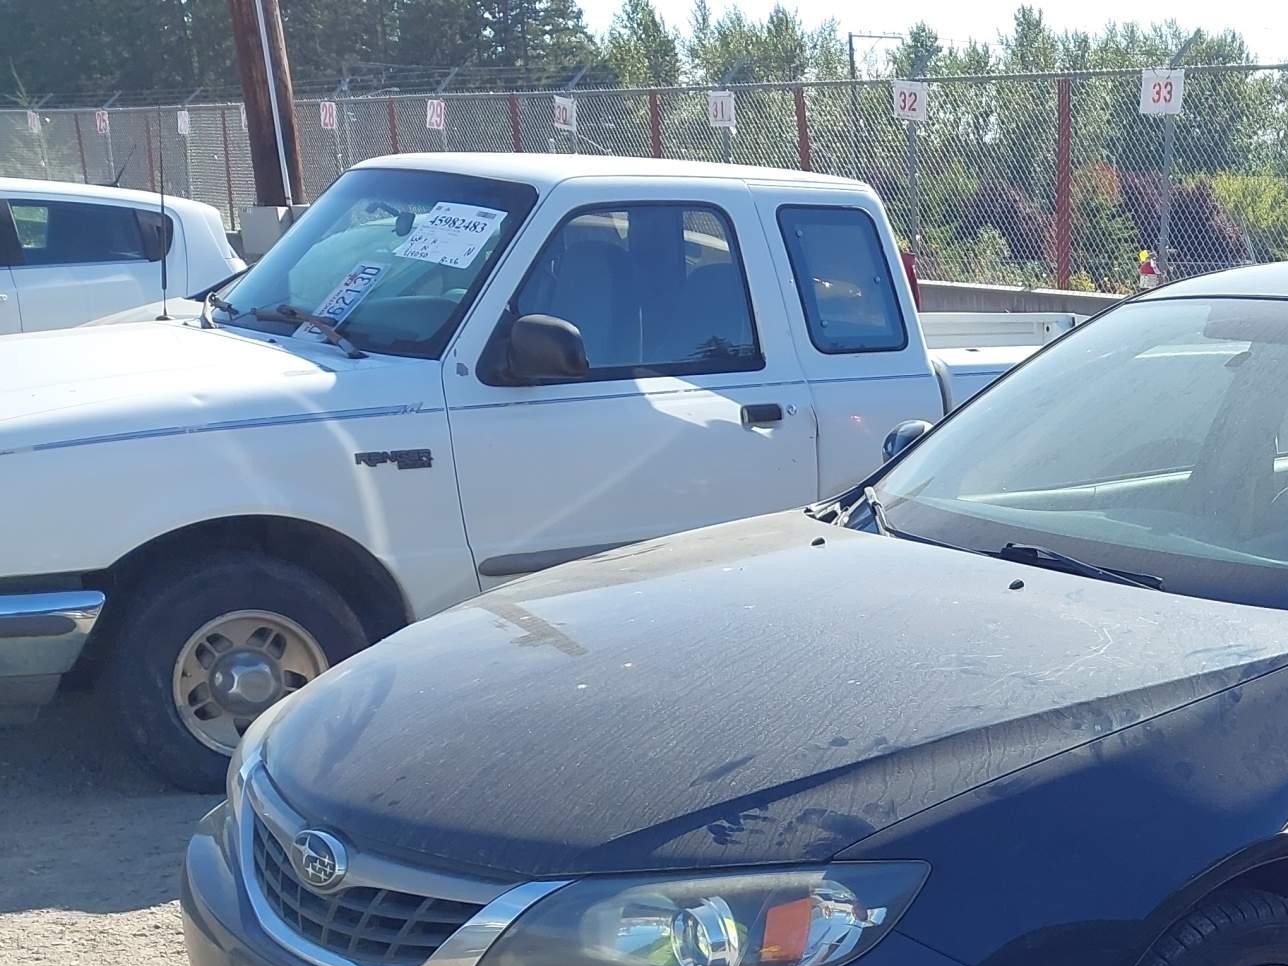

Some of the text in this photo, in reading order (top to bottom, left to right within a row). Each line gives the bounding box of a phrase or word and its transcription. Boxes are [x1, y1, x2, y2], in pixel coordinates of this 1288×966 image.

[899, 90, 917, 111] 32
[1152, 81, 1173, 104] 33
[321, 102, 334, 128] 28
[428, 101, 442, 128] 29
[554, 105, 568, 122] 30
[711, 100, 724, 119] 31
[429, 215, 487, 233] 45982483
